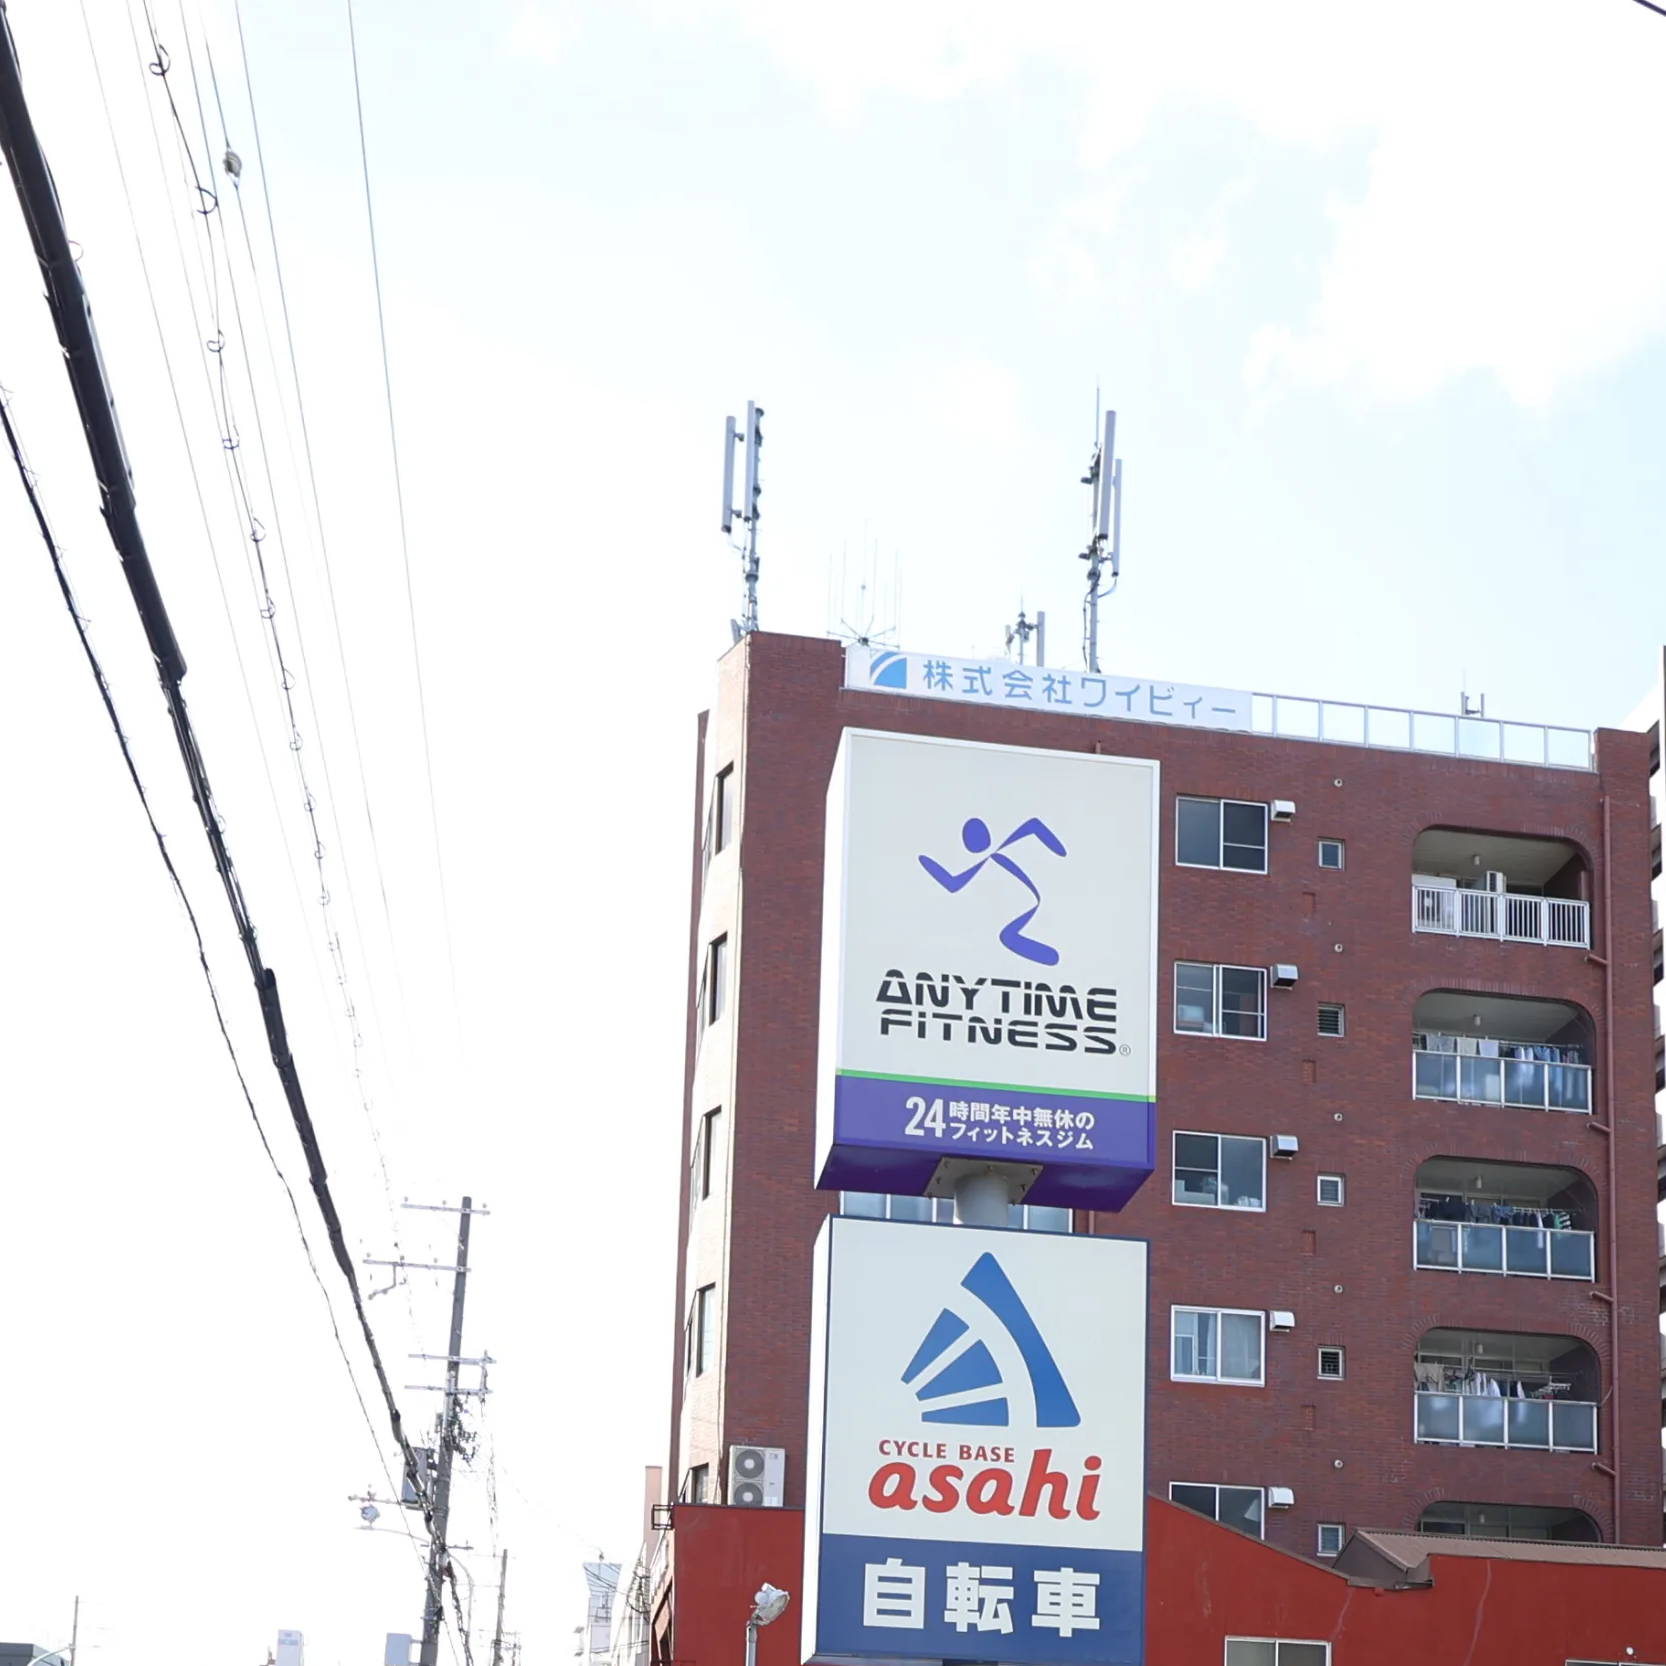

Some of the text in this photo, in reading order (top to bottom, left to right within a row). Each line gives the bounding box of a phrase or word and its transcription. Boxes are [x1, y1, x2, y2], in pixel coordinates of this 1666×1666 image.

[923, 659, 1236, 719] 株式会社ワイビィー
[876, 969, 1117, 1022] ANYTIME
[880, 1008, 1117, 1055] FITNESS
[905, 1096, 1095, 1138] 24 時間年中無休の
[950, 1122, 1094, 1150] フィットネスジム
[879, 1440, 1014, 1463] CYCLE BASE
[868, 1448, 1102, 1521] asahi
[863, 1558, 1100, 1637] 自転車
